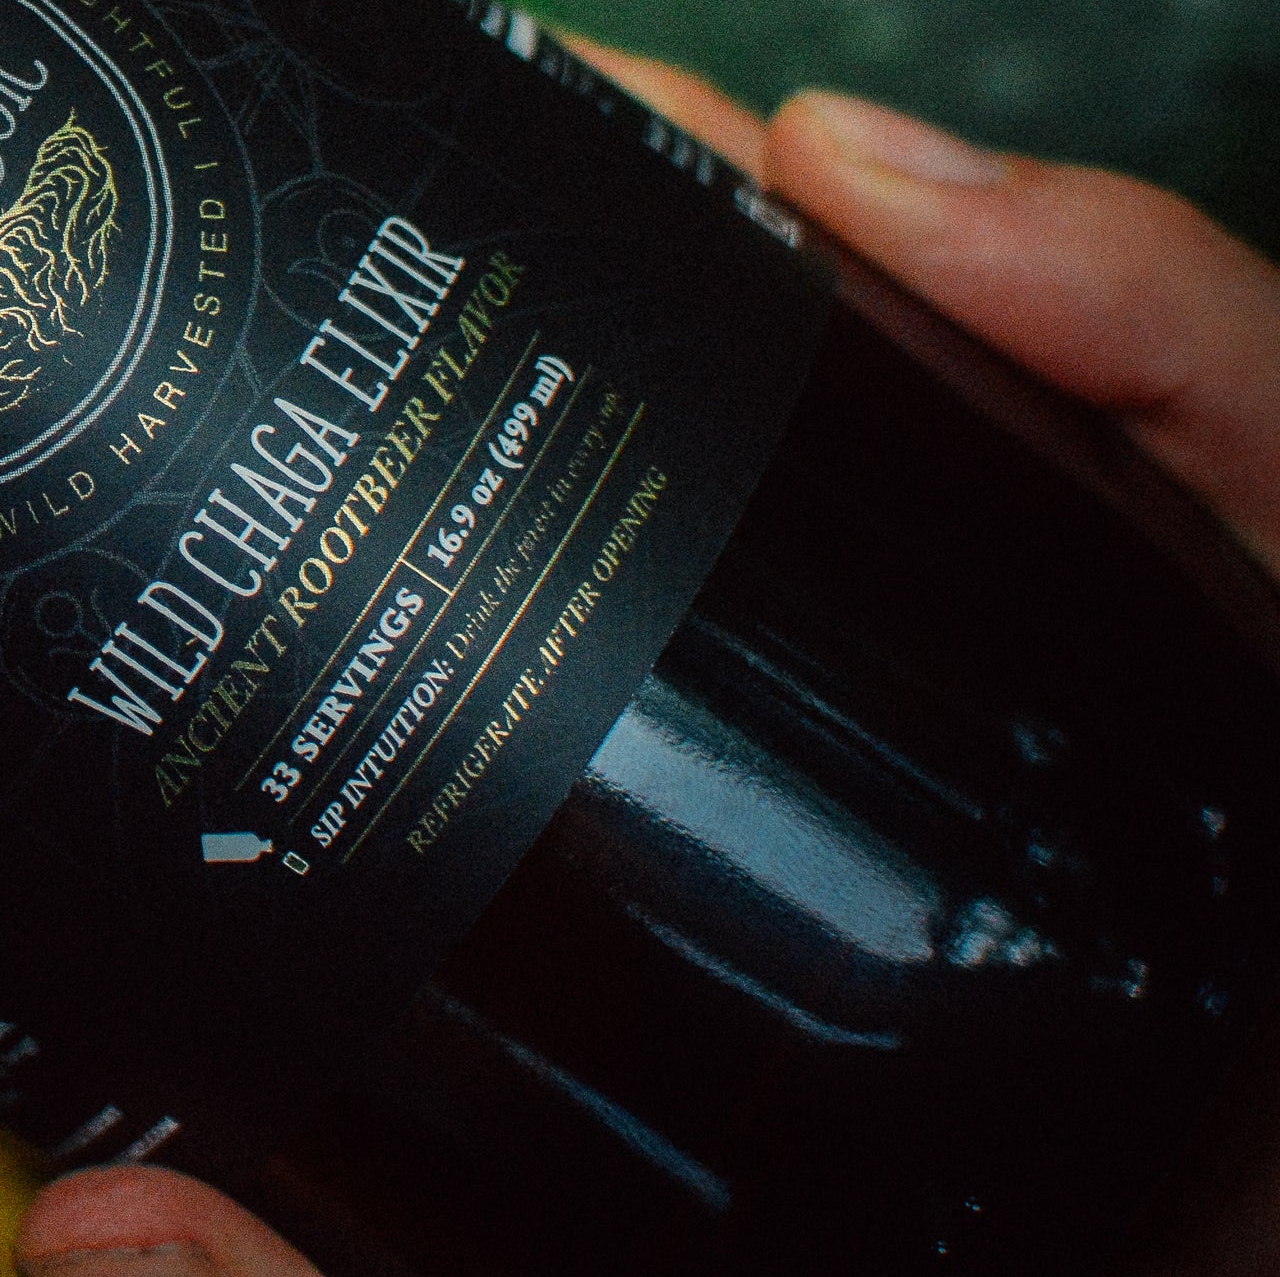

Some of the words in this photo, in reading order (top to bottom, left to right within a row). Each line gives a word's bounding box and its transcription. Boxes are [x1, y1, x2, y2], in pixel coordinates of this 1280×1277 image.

[109, 198, 229, 465] HARVESTED
[487, 401, 539, 469] (499
[529, 355, 575, 406] ml)
[66, 579, 225, 737] WILD
[177, 397, 360, 598] CHAGA
[299, 215, 466, 413] ELIXIR
[155, 614, 288, 808] ANCIENT
[278, 396, 440, 627] ROOTBEER
[423, 249, 526, 404] FLAVOR
[427, 503, 476, 568] 16.9
[471, 467, 504, 506] oz
[260, 761, 302, 803] 33
[291, 586, 424, 763] SERVINGS
[310, 800, 347, 848] SIP
[340, 659, 454, 809] INTUITION:
[445, 590, 500, 661] Drink
[494, 557, 521, 594] the
[405, 667, 544, 856] REFRIGERATE
[538, 581, 601, 674] AFTER
[592, 465, 669, 582] OPENING
